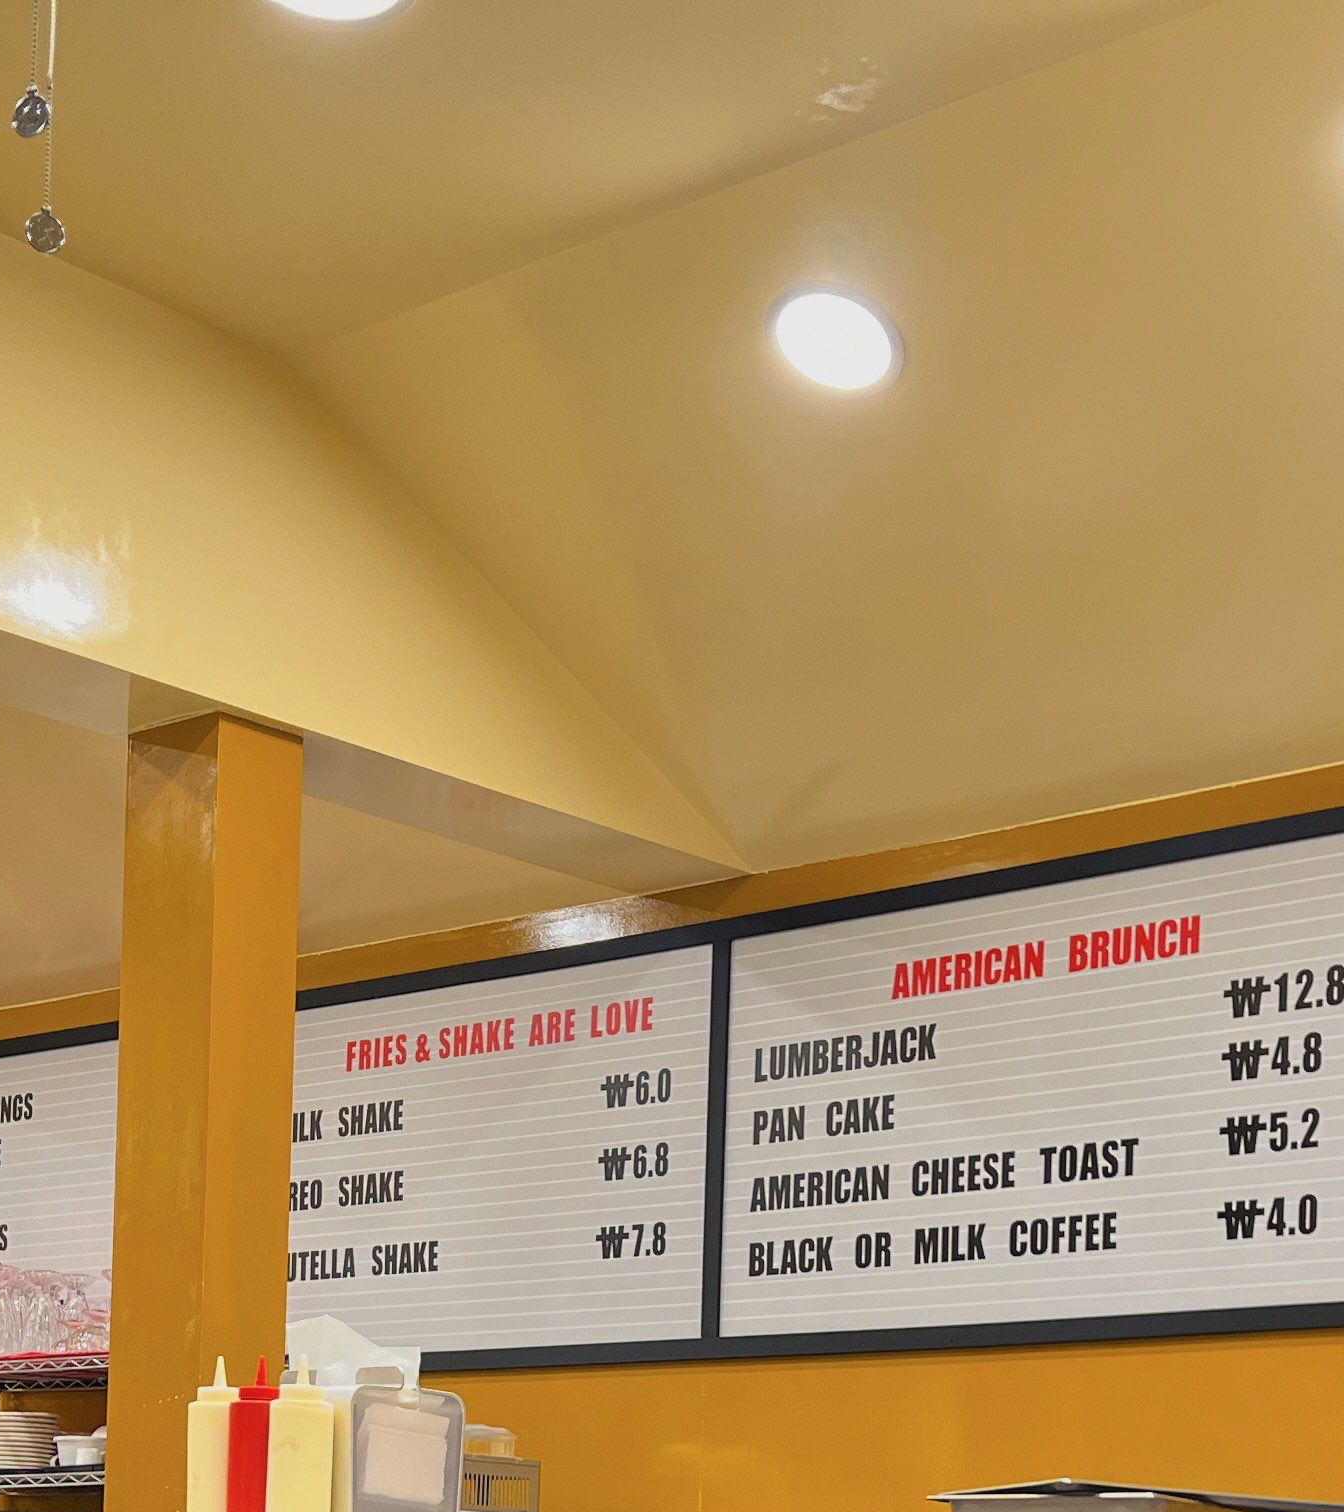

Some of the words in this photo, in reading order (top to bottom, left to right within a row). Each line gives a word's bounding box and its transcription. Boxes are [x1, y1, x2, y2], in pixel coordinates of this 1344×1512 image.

[893, 941, 1044, 999] AMERICAN
[1069, 916, 1200, 972] BRUNCH
[347, 1035, 407, 1072] FRIES
[416, 1034, 430, 1062] &
[440, 1018, 514, 1058] SHAKE
[529, 1009, 575, 1046] ARE
[591, 998, 653, 1038] LOVE
[755, 1023, 936, 1082] LUMBERJACK
[1224, 965, 1344, 1018] ₩12.8
[293, 1110, 322, 1142] ILK
[339, 1100, 403, 1137] SHAKE
[601, 1068, 671, 1108] ₩6.0
[753, 1106, 805, 1145] PAN
[827, 1095, 894, 1136] CAKE
[1222, 1032, 1321, 1081] ₩4.8
[289, 1180, 322, 1211] REO
[339, 1171, 403, 1206] SHAKE
[598, 1143, 668, 1181] ₩6.8
[750, 1165, 889, 1212] AMERICAN
[912, 1151, 1015, 1196] CHEESE
[1040, 1138, 1138, 1184] TOAST
[1220, 1108, 1319, 1155] ₩5.2
[287, 1248, 355, 1282] UTELLA
[372, 1241, 438, 1275] SHAKE
[596, 1222, 666, 1259] ₩7.8
[749, 1237, 833, 1276] BLACK
[856, 1232, 891, 1268] OR
[914, 1224, 985, 1264] MILK
[1010, 1212, 1116, 1256] COFFEE
[1217, 1195, 1317, 1240] ₩4.0
